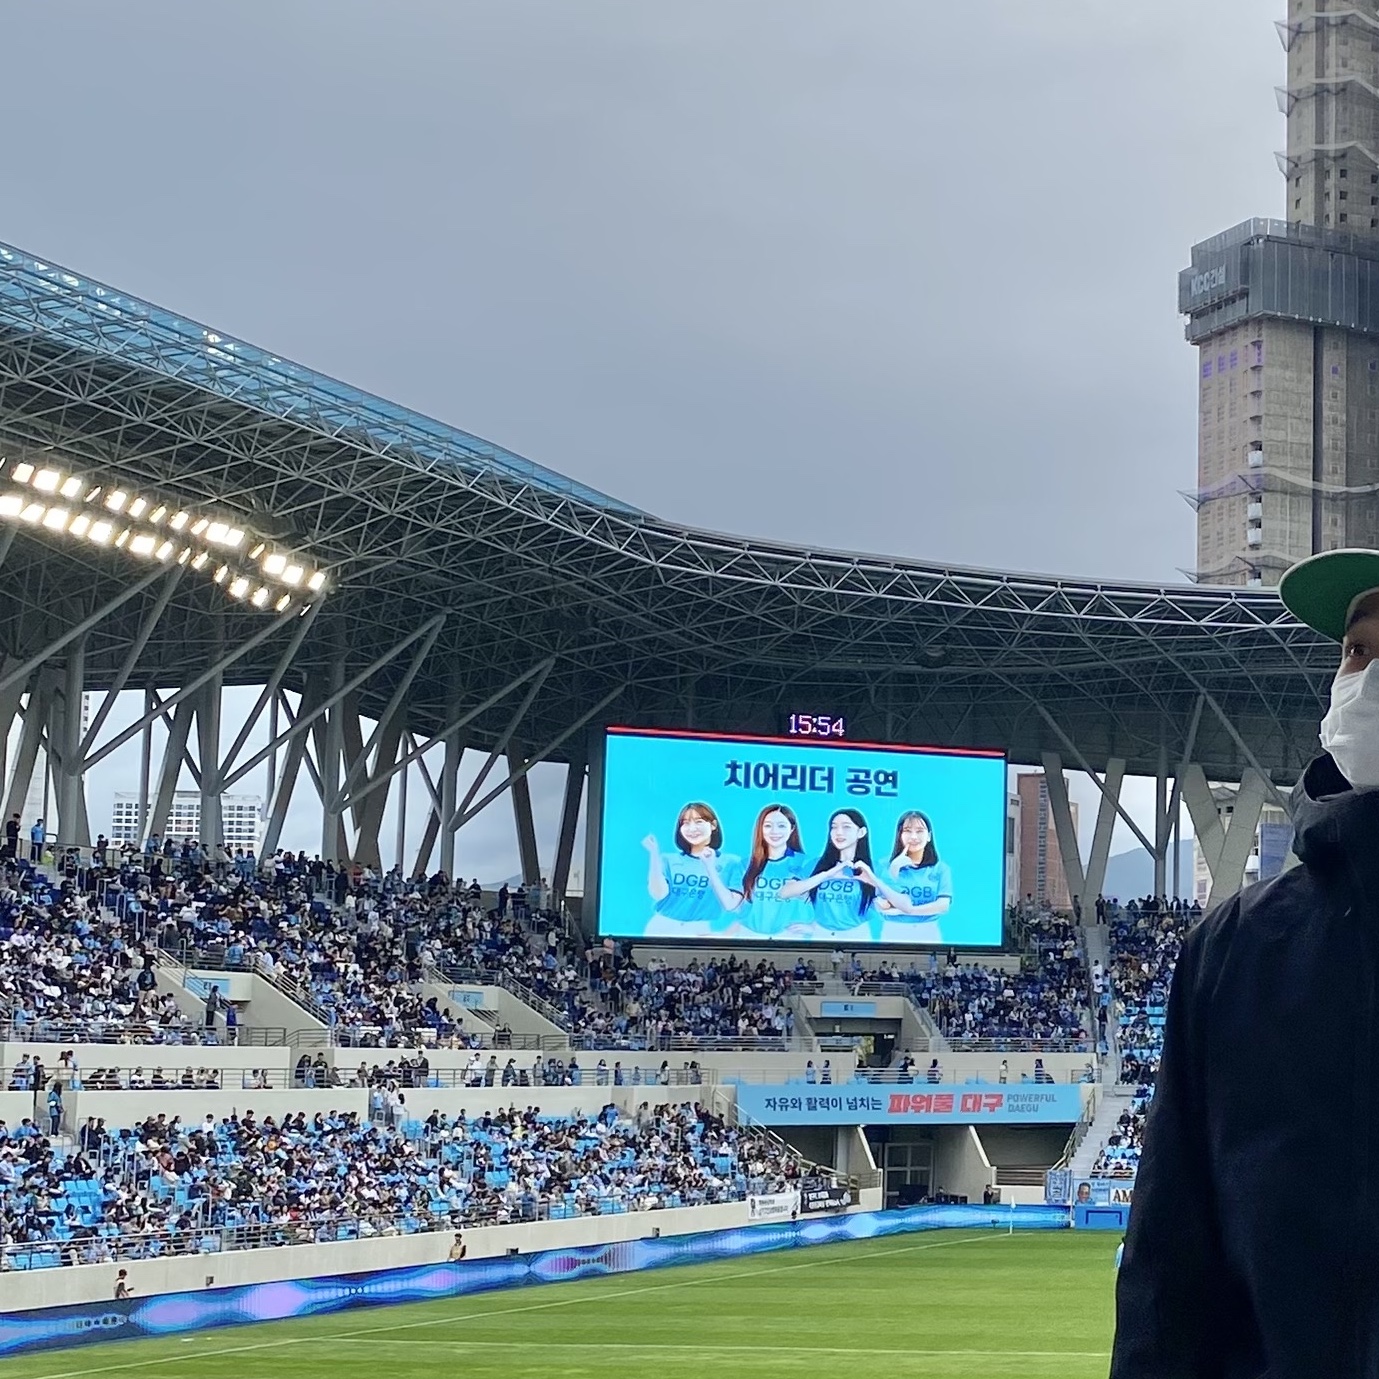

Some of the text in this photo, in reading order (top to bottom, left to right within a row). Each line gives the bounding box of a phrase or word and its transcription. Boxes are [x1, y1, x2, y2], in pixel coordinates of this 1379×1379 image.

[1190, 264, 1226, 297] KCC건설
[789, 713, 845, 737] 15:54
[724, 760, 899, 797] 치어리더 공연
[674, 873, 710, 888] DGB
[765, 1092, 1004, 1114] 자유와 활력이 넘치는 파워풀 대구
[1007, 1093, 1057, 1103] POWERFUL
[1007, 1103, 1040, 1113] DAEGU
